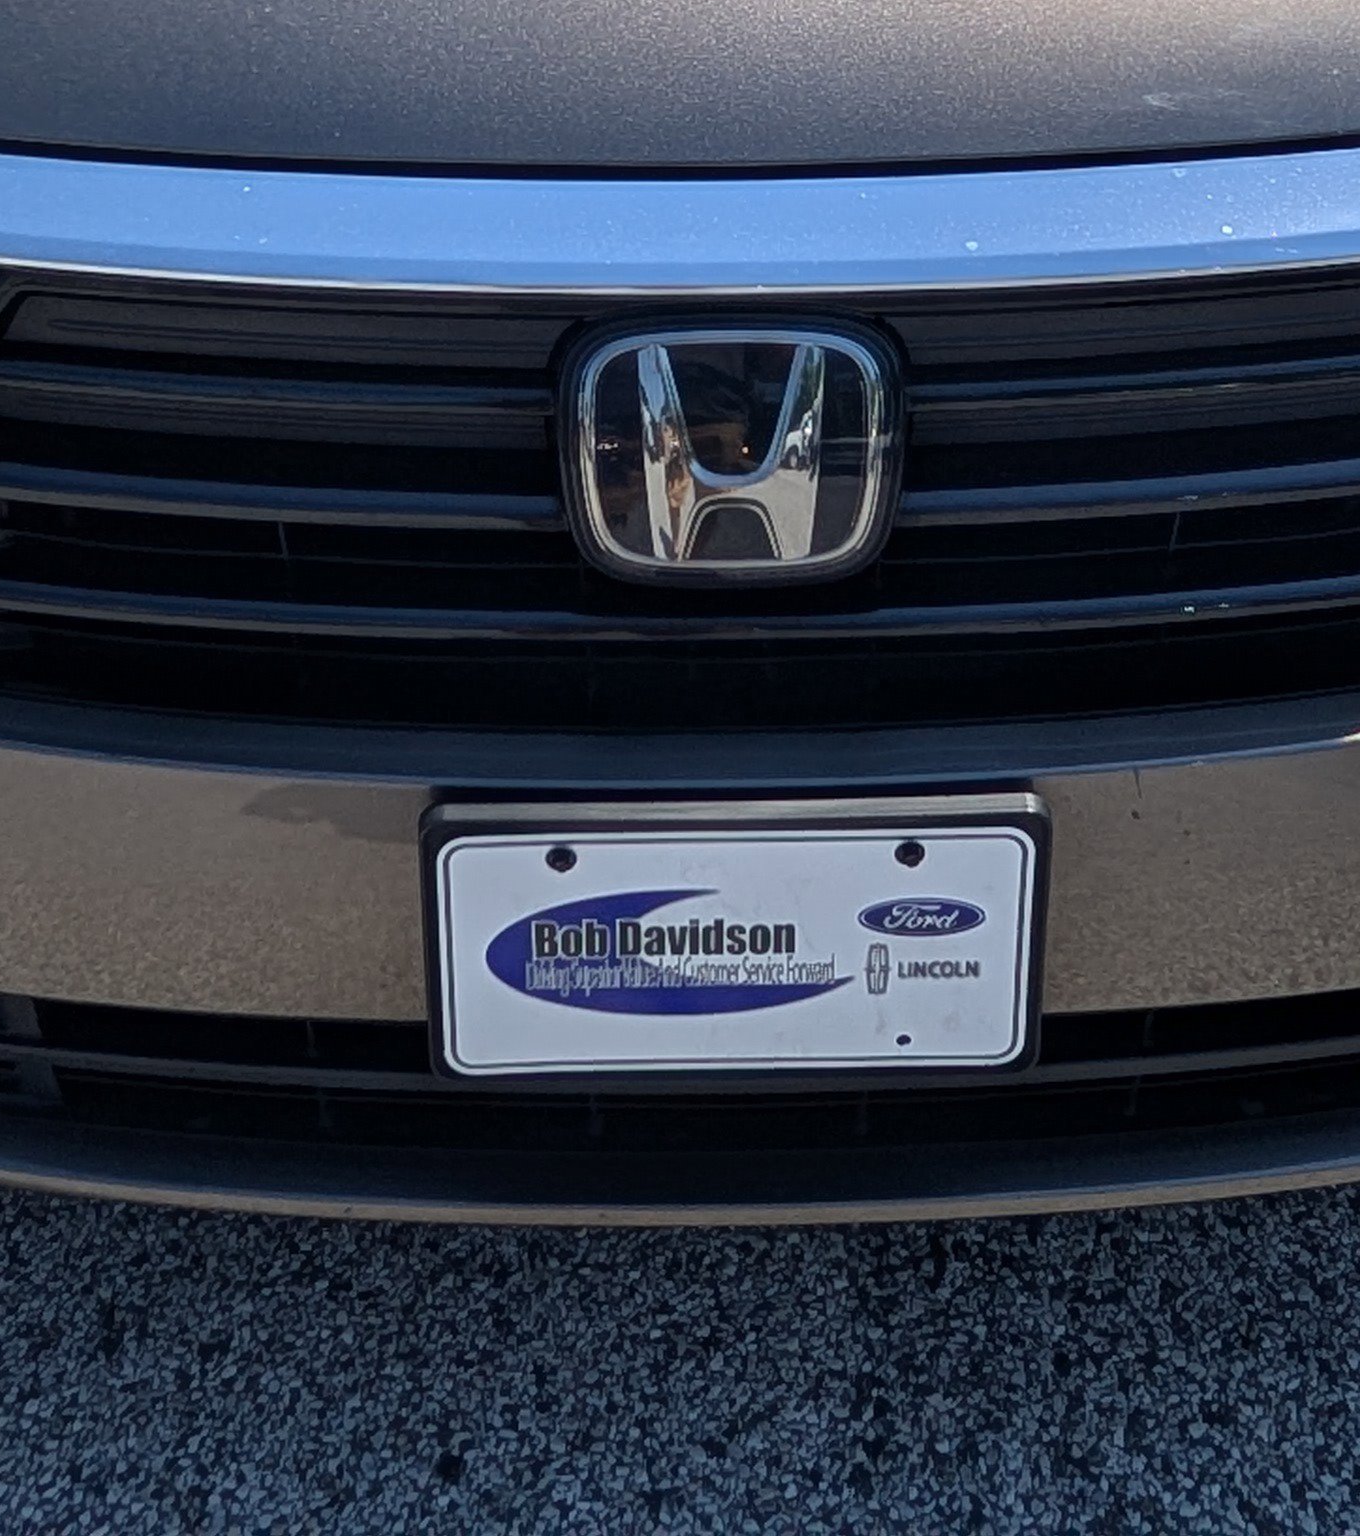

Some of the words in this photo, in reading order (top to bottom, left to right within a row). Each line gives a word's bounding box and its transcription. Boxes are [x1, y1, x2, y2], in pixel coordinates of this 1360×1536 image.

[883, 904, 960, 929] Ford
[532, 920, 610, 959] Bob
[617, 918, 796, 957] Davidson
[683, 955, 741, 989] Customer
[742, 954, 785, 985] Service
[786, 952, 836, 984] Forward
[897, 960, 980, 979] LINCOLN
